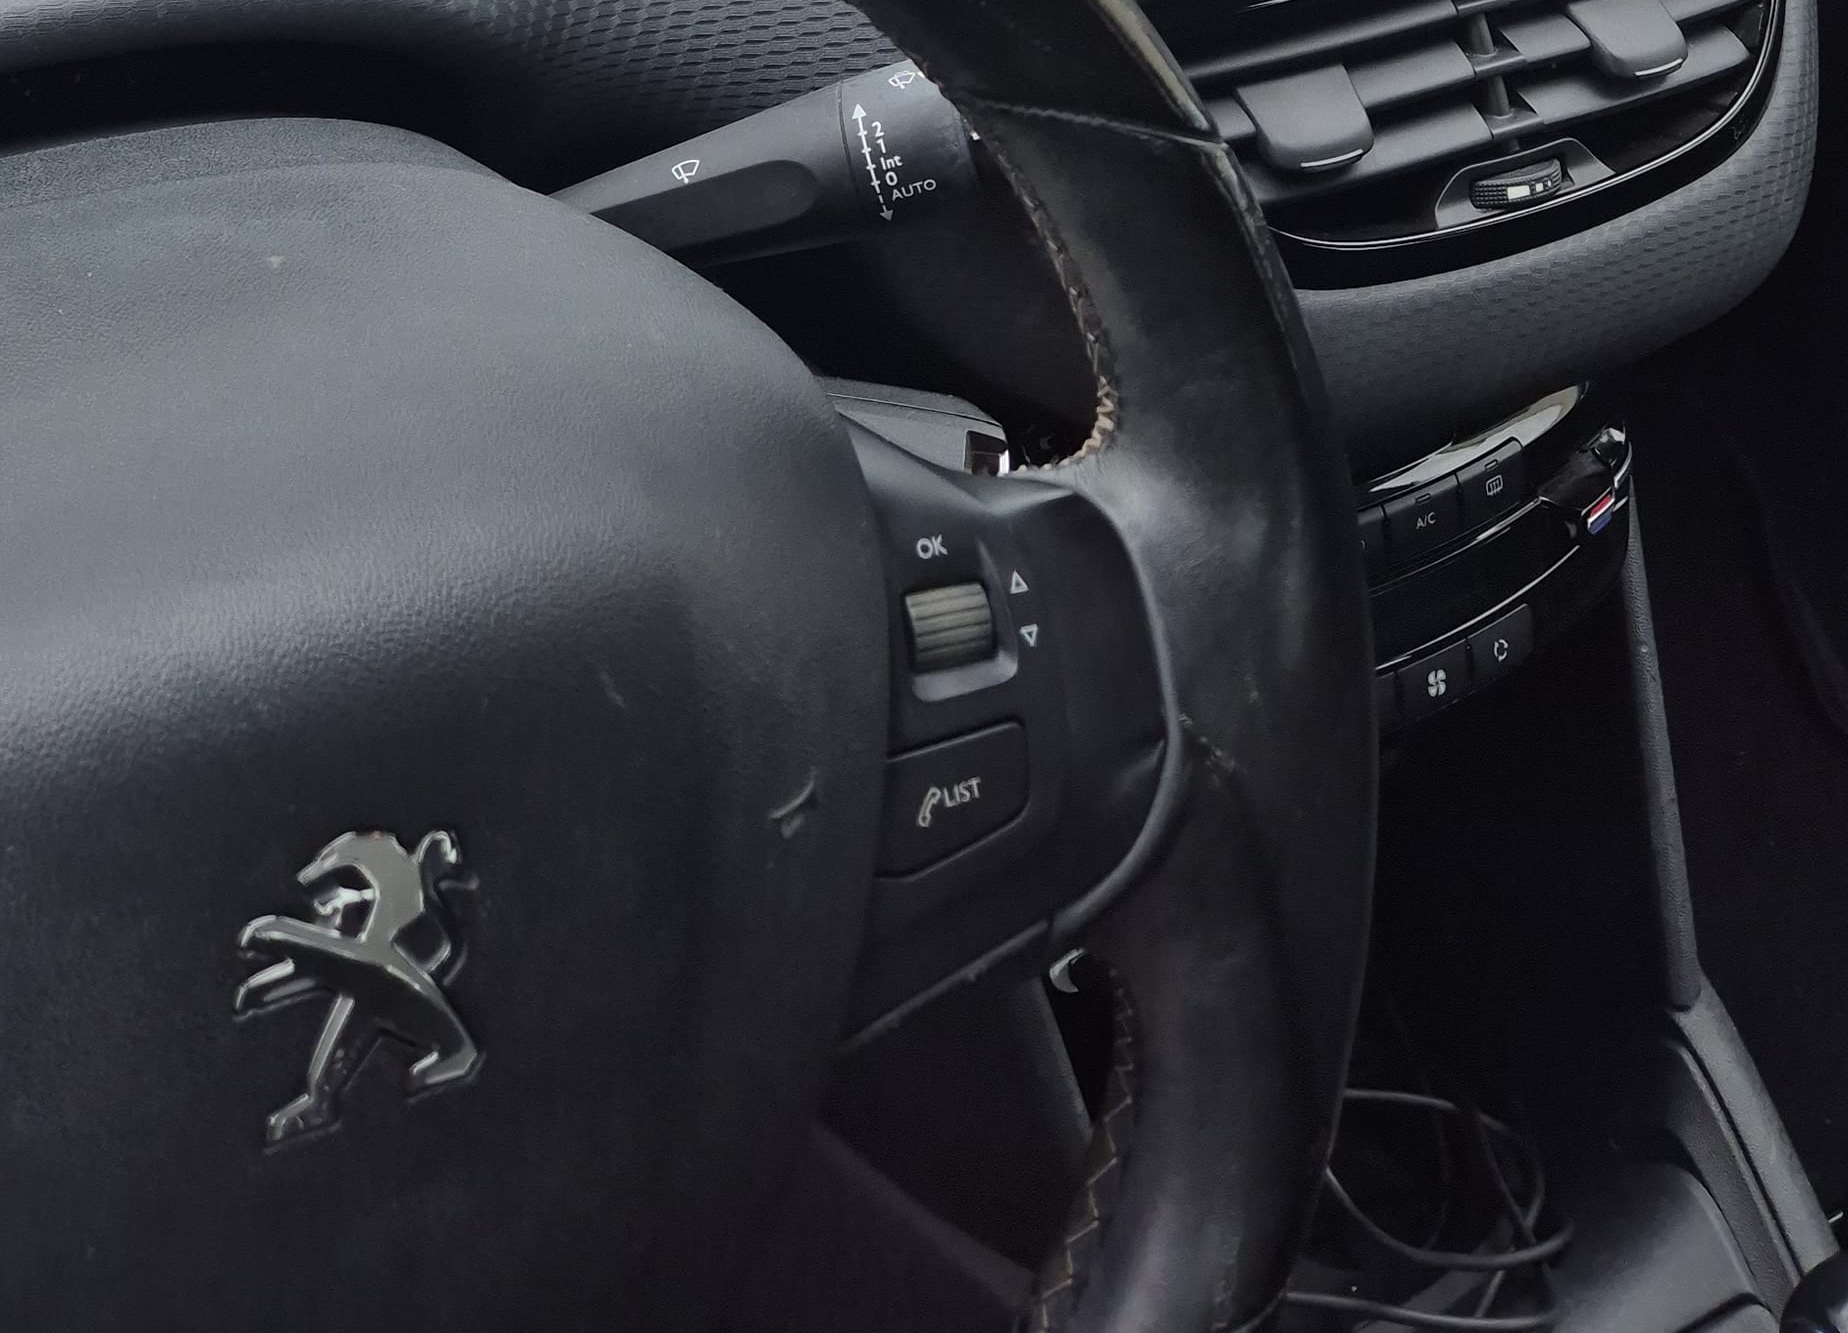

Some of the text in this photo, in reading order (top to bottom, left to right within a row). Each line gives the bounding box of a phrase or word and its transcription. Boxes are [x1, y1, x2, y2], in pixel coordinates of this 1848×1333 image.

[872, 121, 884, 138] 2
[877, 137, 887, 154] 1
[880, 155, 903, 171] Int
[891, 179, 937, 202] AUTO
[1416, 511, 1436, 531] A/C
[916, 534, 948, 560] OK
[942, 777, 981, 807] LIST
